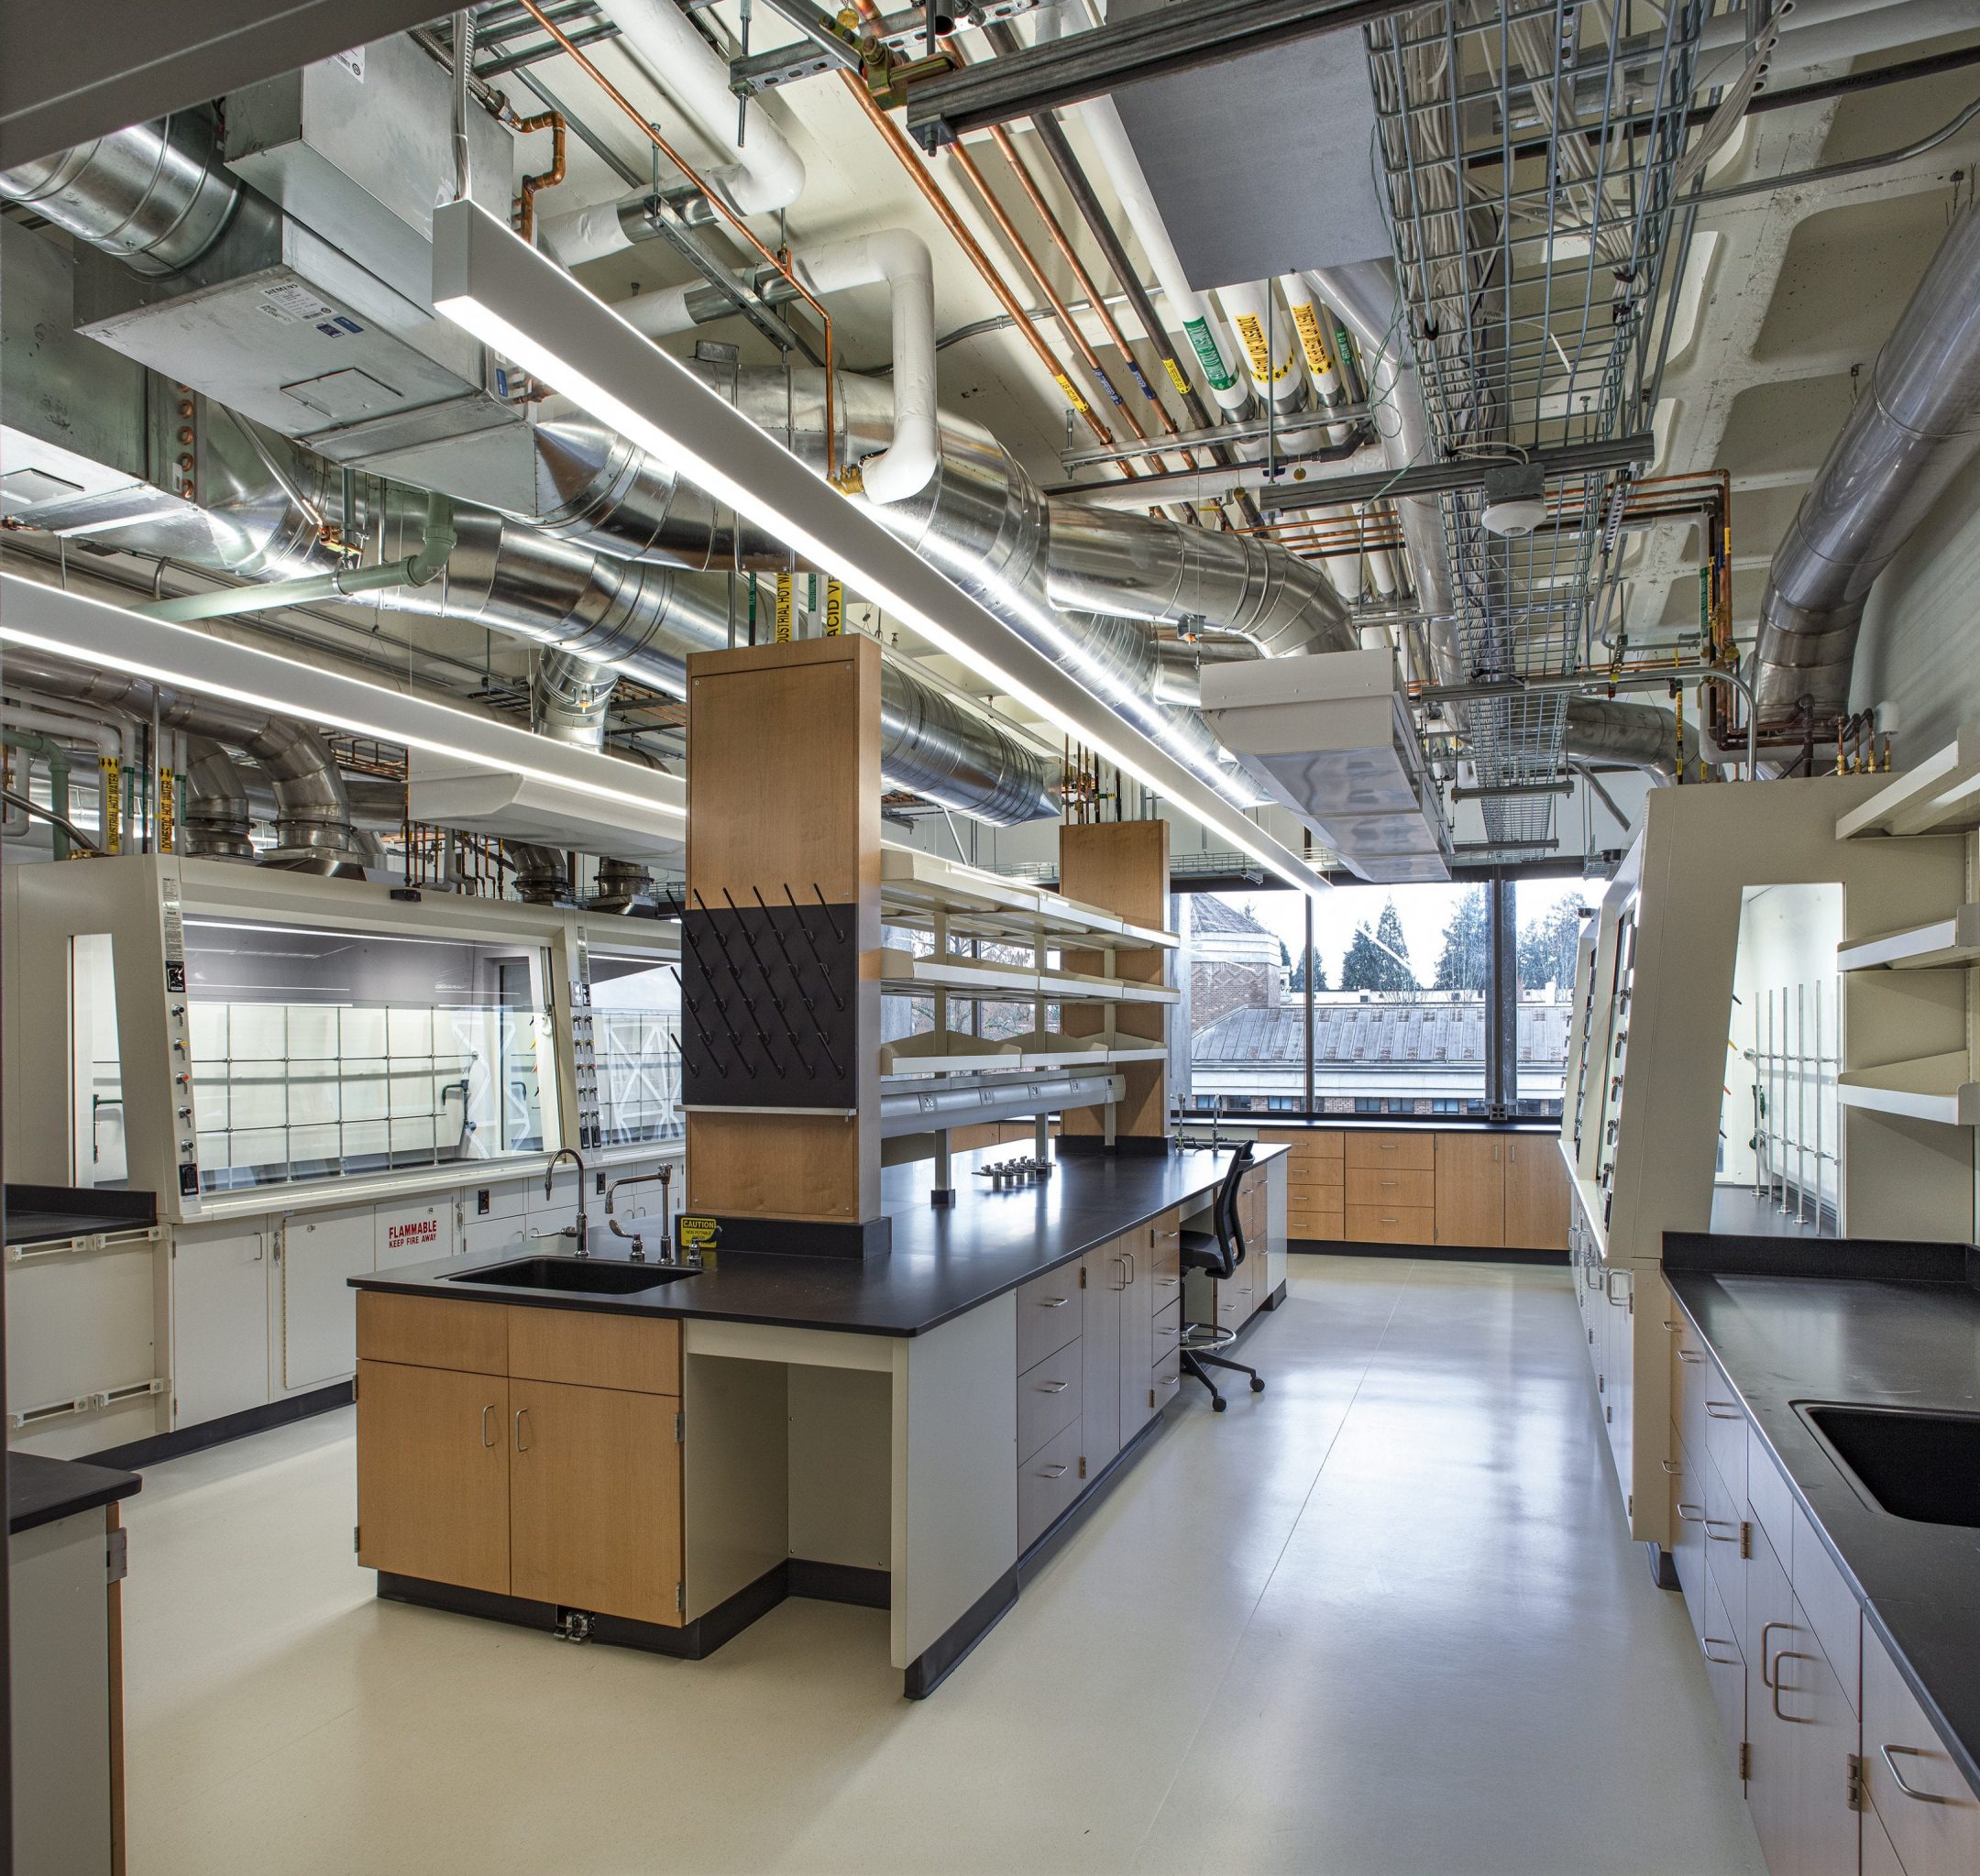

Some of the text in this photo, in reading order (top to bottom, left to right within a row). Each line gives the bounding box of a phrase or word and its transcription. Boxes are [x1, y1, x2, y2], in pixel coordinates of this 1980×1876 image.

[264, 283, 298, 295] SIEMENS
[777, 587, 790, 603] HOT
[827, 599, 840, 637] ACID
[108, 773, 119, 846] INDUSTRIAL HOT WATER
[161, 781, 172, 849] DOMESTIC HOT WATER
[389, 1220, 437, 1239] FLAMMABLE
[683, 1220, 714, 1228] CAUTION
[389, 1233, 437, 1248] KEEP FIRE AWAY
